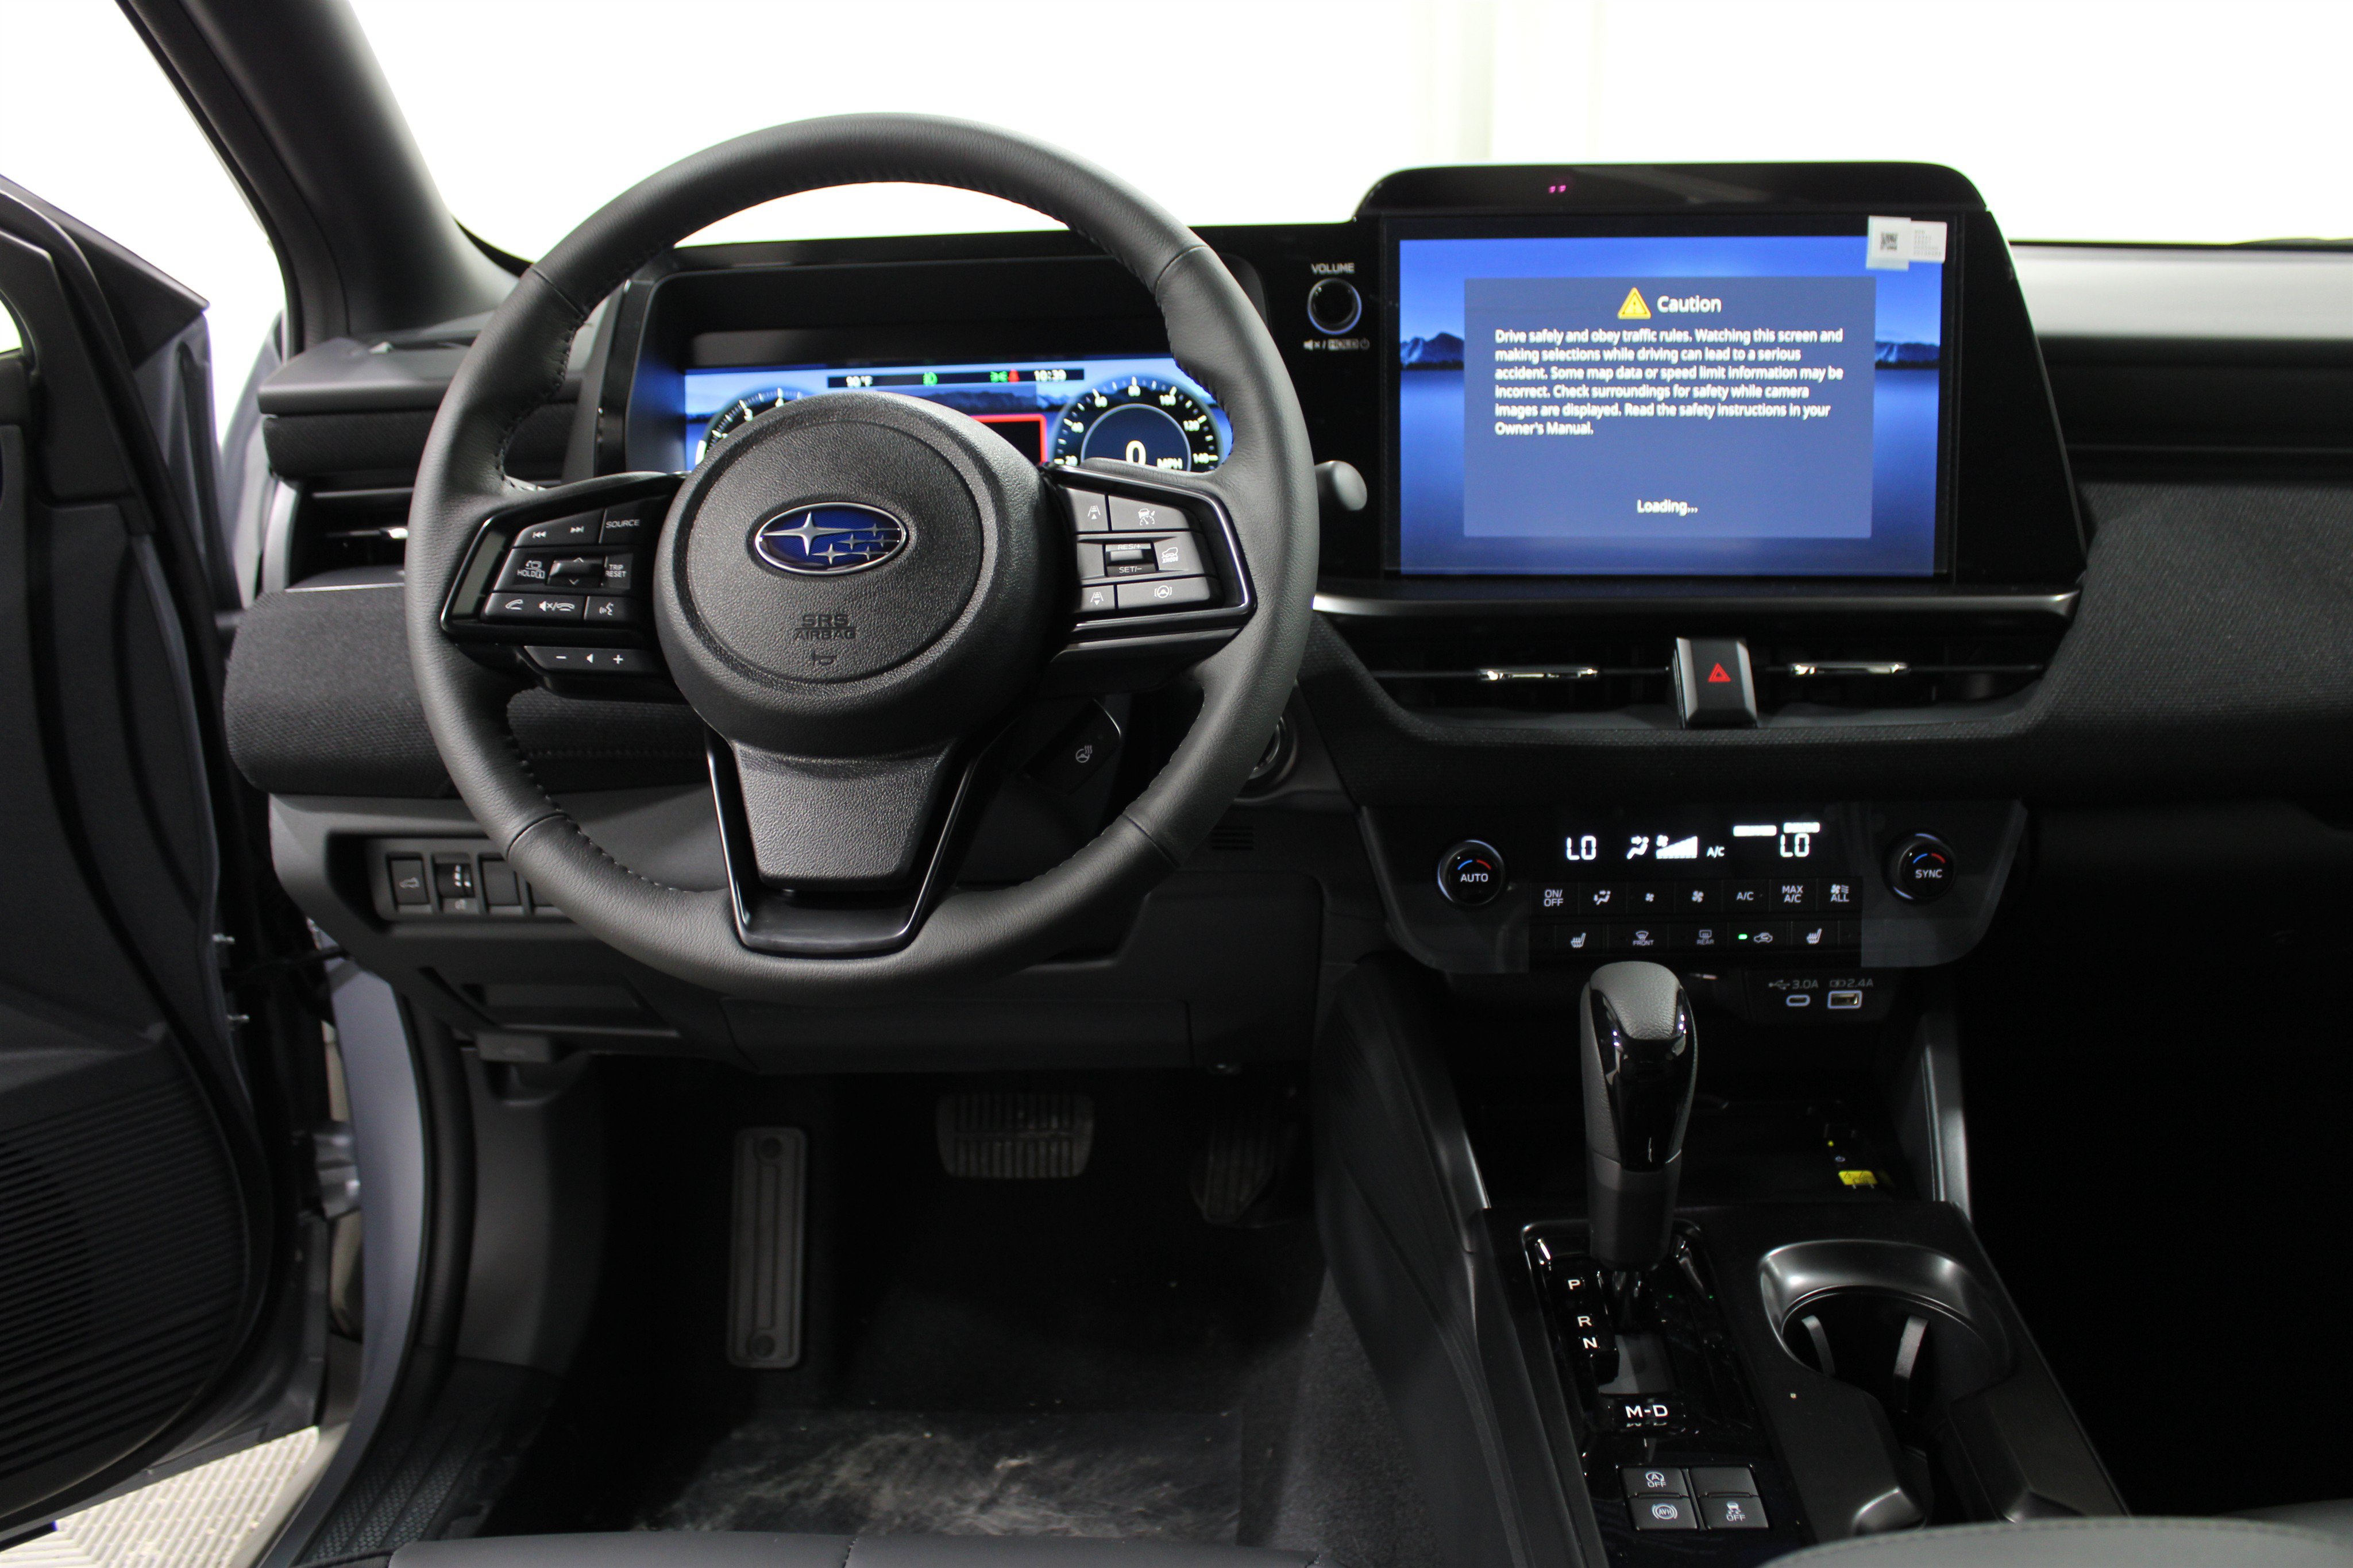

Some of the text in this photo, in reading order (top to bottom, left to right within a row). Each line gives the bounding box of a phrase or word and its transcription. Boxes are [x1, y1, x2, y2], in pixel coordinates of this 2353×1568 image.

[1311, 262, 1355, 275] VOLUME
[1657, 295, 1722, 313] Caution
[1495, 327, 1843, 346] Drive safely and obey traffic rules. Watching this screen and
[1495, 346, 1802, 365] making selections while driving can lead to a serious
[1034, 369, 1067, 382] 10:39
[1494, 365, 1844, 383] accident. Some map data or speed limit information may be
[1495, 383, 1810, 401] incorrect. Check surroundings for safety while camera
[1159, 395, 1176, 405] 100
[743, 408, 753, 422] 3
[1495, 402, 1831, 420] images are displayed. Read the safety instructions in your
[1495, 420, 1594, 435] Owner's Manual.
[1125, 440, 1146, 466] 0
[1156, 457, 1183, 470] MPH
[1637, 499, 1698, 516] Loading...
[605, 519, 640, 528] SOURCE
[803, 614, 849, 627] SRS
[794, 629, 856, 640] AIRBAG
[1706, 845, 1725, 858] A/C
[1460, 873, 1488, 882] AUTO
[1915, 869, 1942, 879] SYNC
[1545, 890, 1563, 898] ON/
[1782, 885, 1803, 894] MAX
[1737, 891, 1754, 901] A/C
[1784, 894, 1802, 903] A/C
[1830, 894, 1849, 902] ALL
[1544, 898, 1563, 907] OFF
[1792, 979, 1819, 990] 3.0A
[1847, 979, 1874, 988] 2.4A
[1568, 1279, 1581, 1290] P
[1577, 1315, 1592, 1327] R
[1583, 1337, 1598, 1349] N
[1658, 1507, 1673, 1516] AVH
